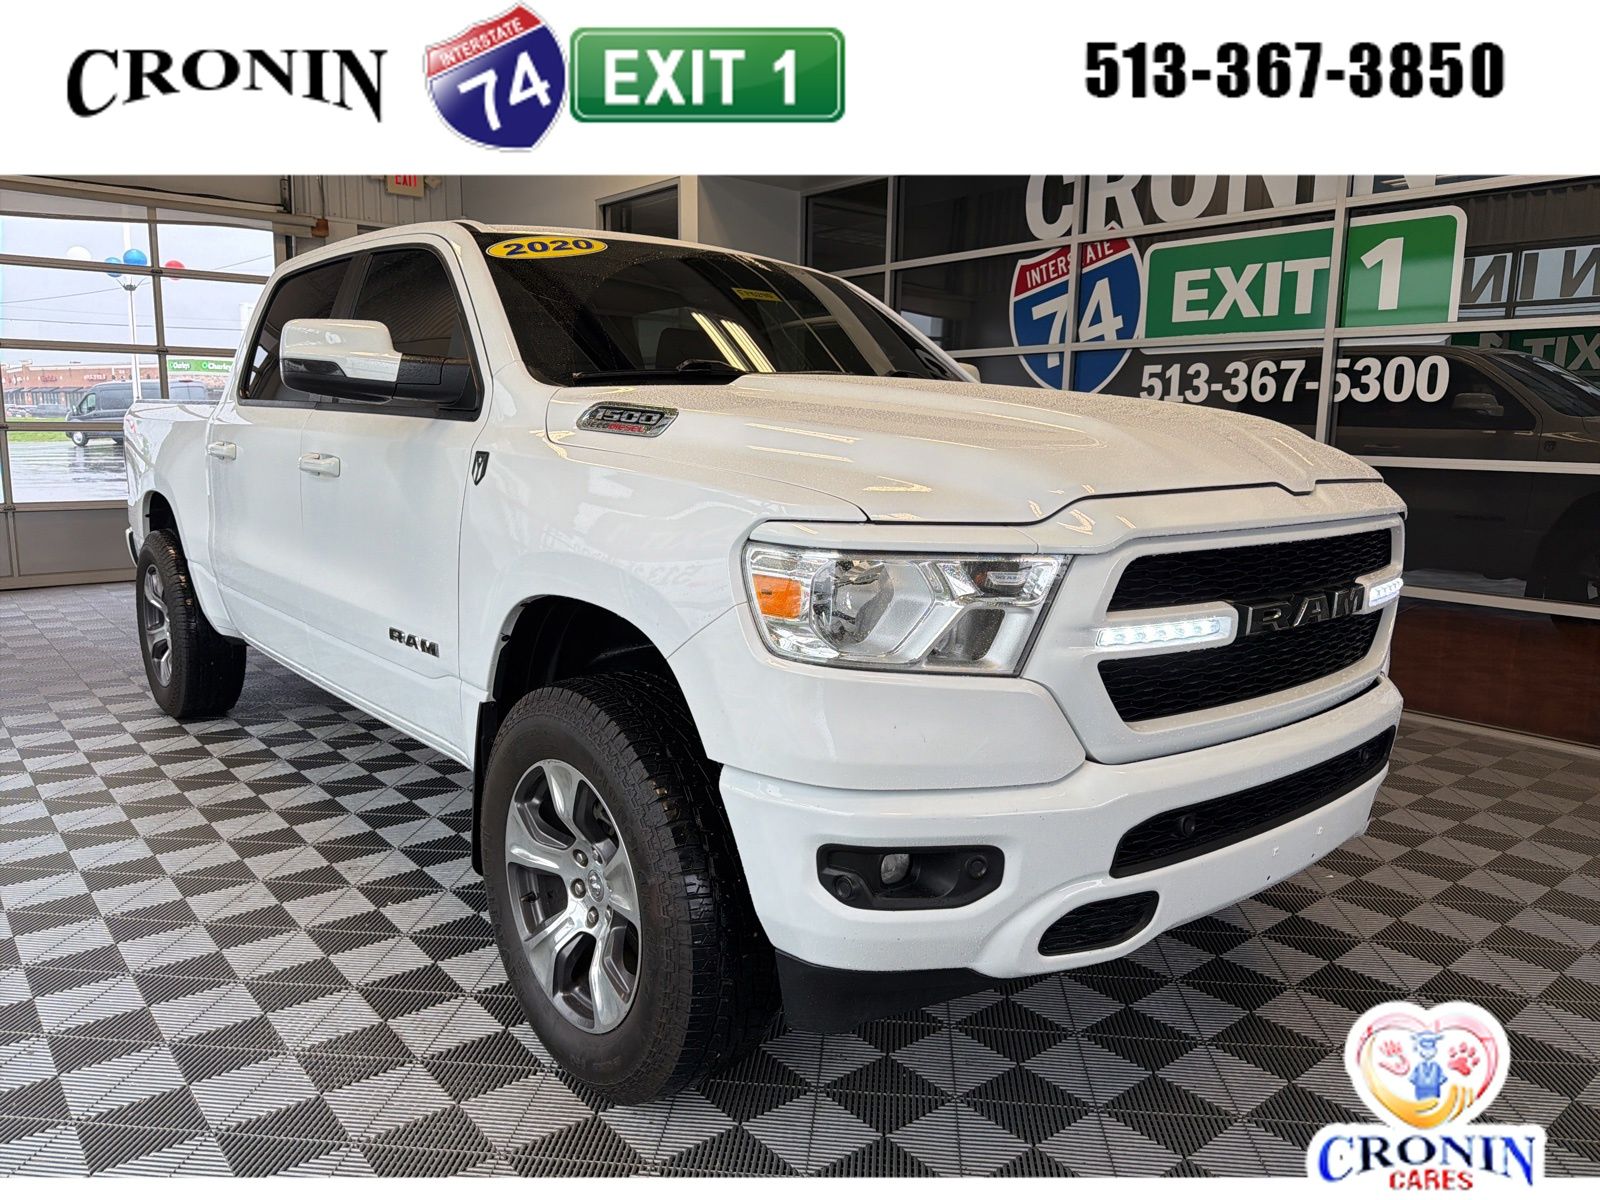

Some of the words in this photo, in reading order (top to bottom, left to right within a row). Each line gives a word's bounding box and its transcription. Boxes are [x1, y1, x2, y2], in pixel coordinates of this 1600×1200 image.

[503, 240, 592, 256] 2020
[1026, 241, 1114, 288] INTERSATE
[1171, 256, 1331, 323] EXIT
[1360, 237, 1404, 311] 1
[1031, 277, 1124, 369] 74
[1139, 355, 1450, 403] 513-367-5300
[595, 408, 661, 425] 1500
[1246, 586, 1364, 636] RAM
[389, 626, 440, 658] RAM
